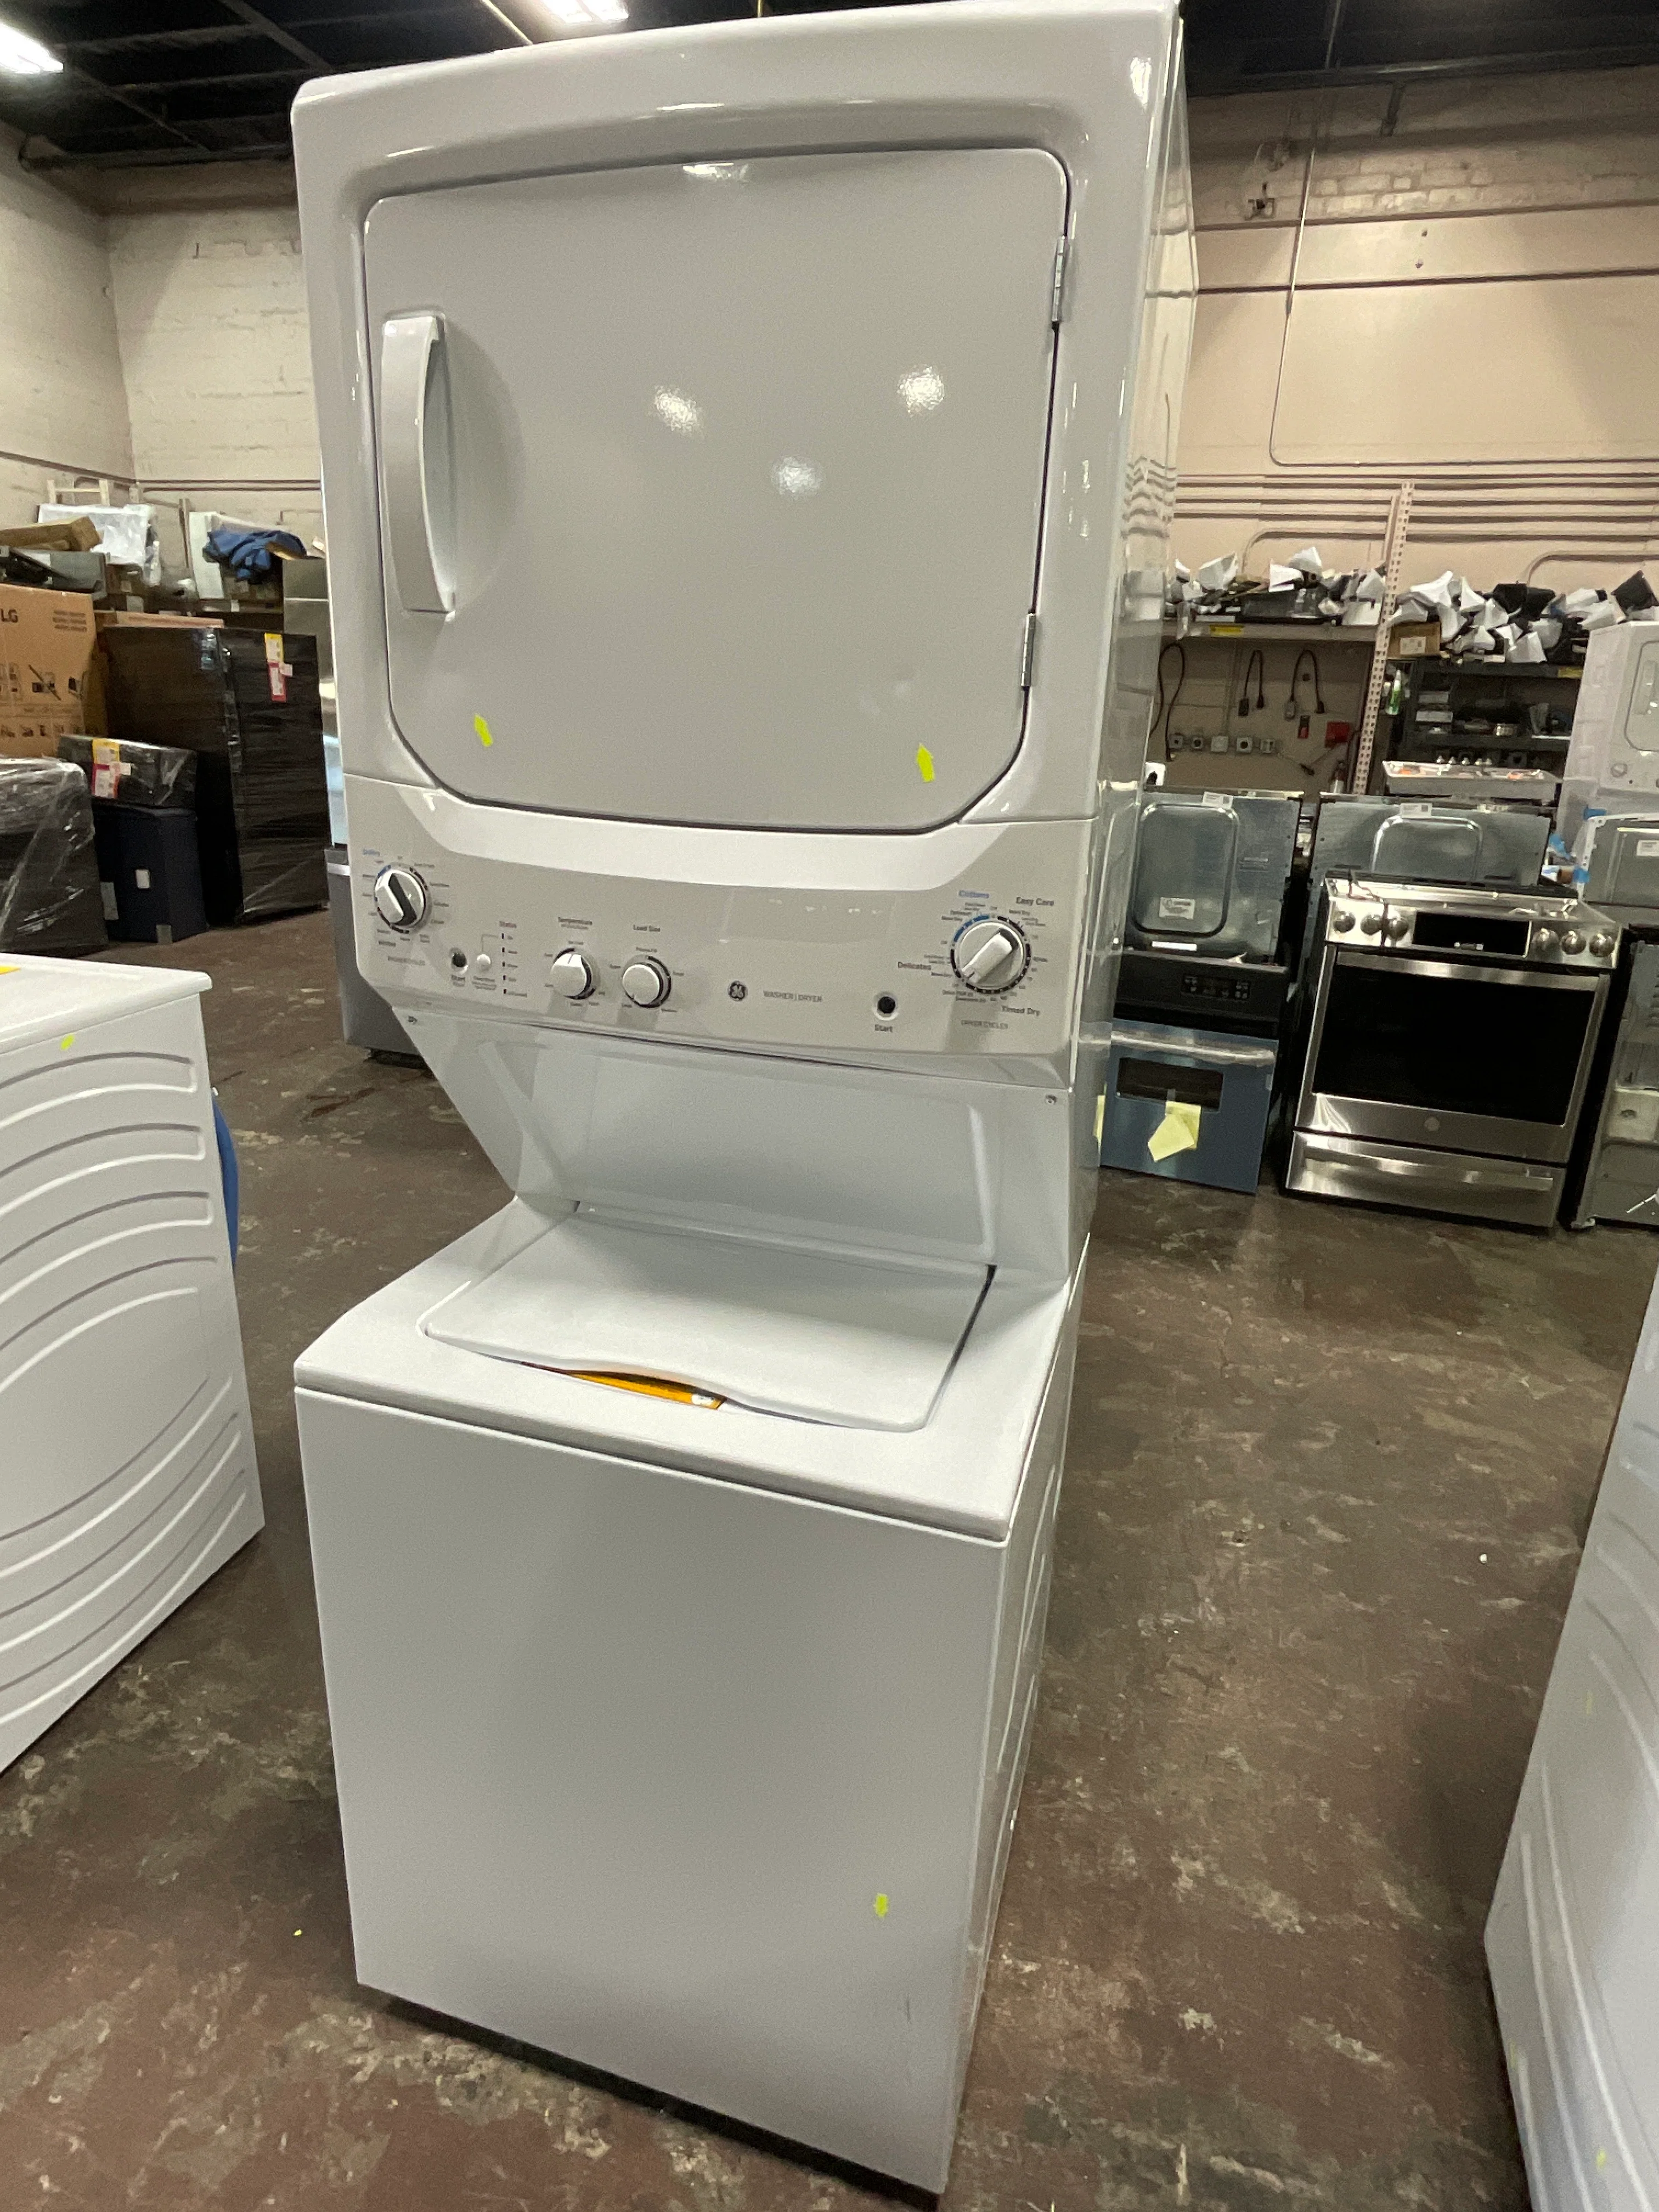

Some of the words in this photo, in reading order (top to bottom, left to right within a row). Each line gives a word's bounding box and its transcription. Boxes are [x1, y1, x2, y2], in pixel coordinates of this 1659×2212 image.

[1, 608, 18, 623] LG
[1016, 896, 1034, 906] Easy
[1036, 898, 1054, 906] Care
[874, 1024, 893, 1032] Start
